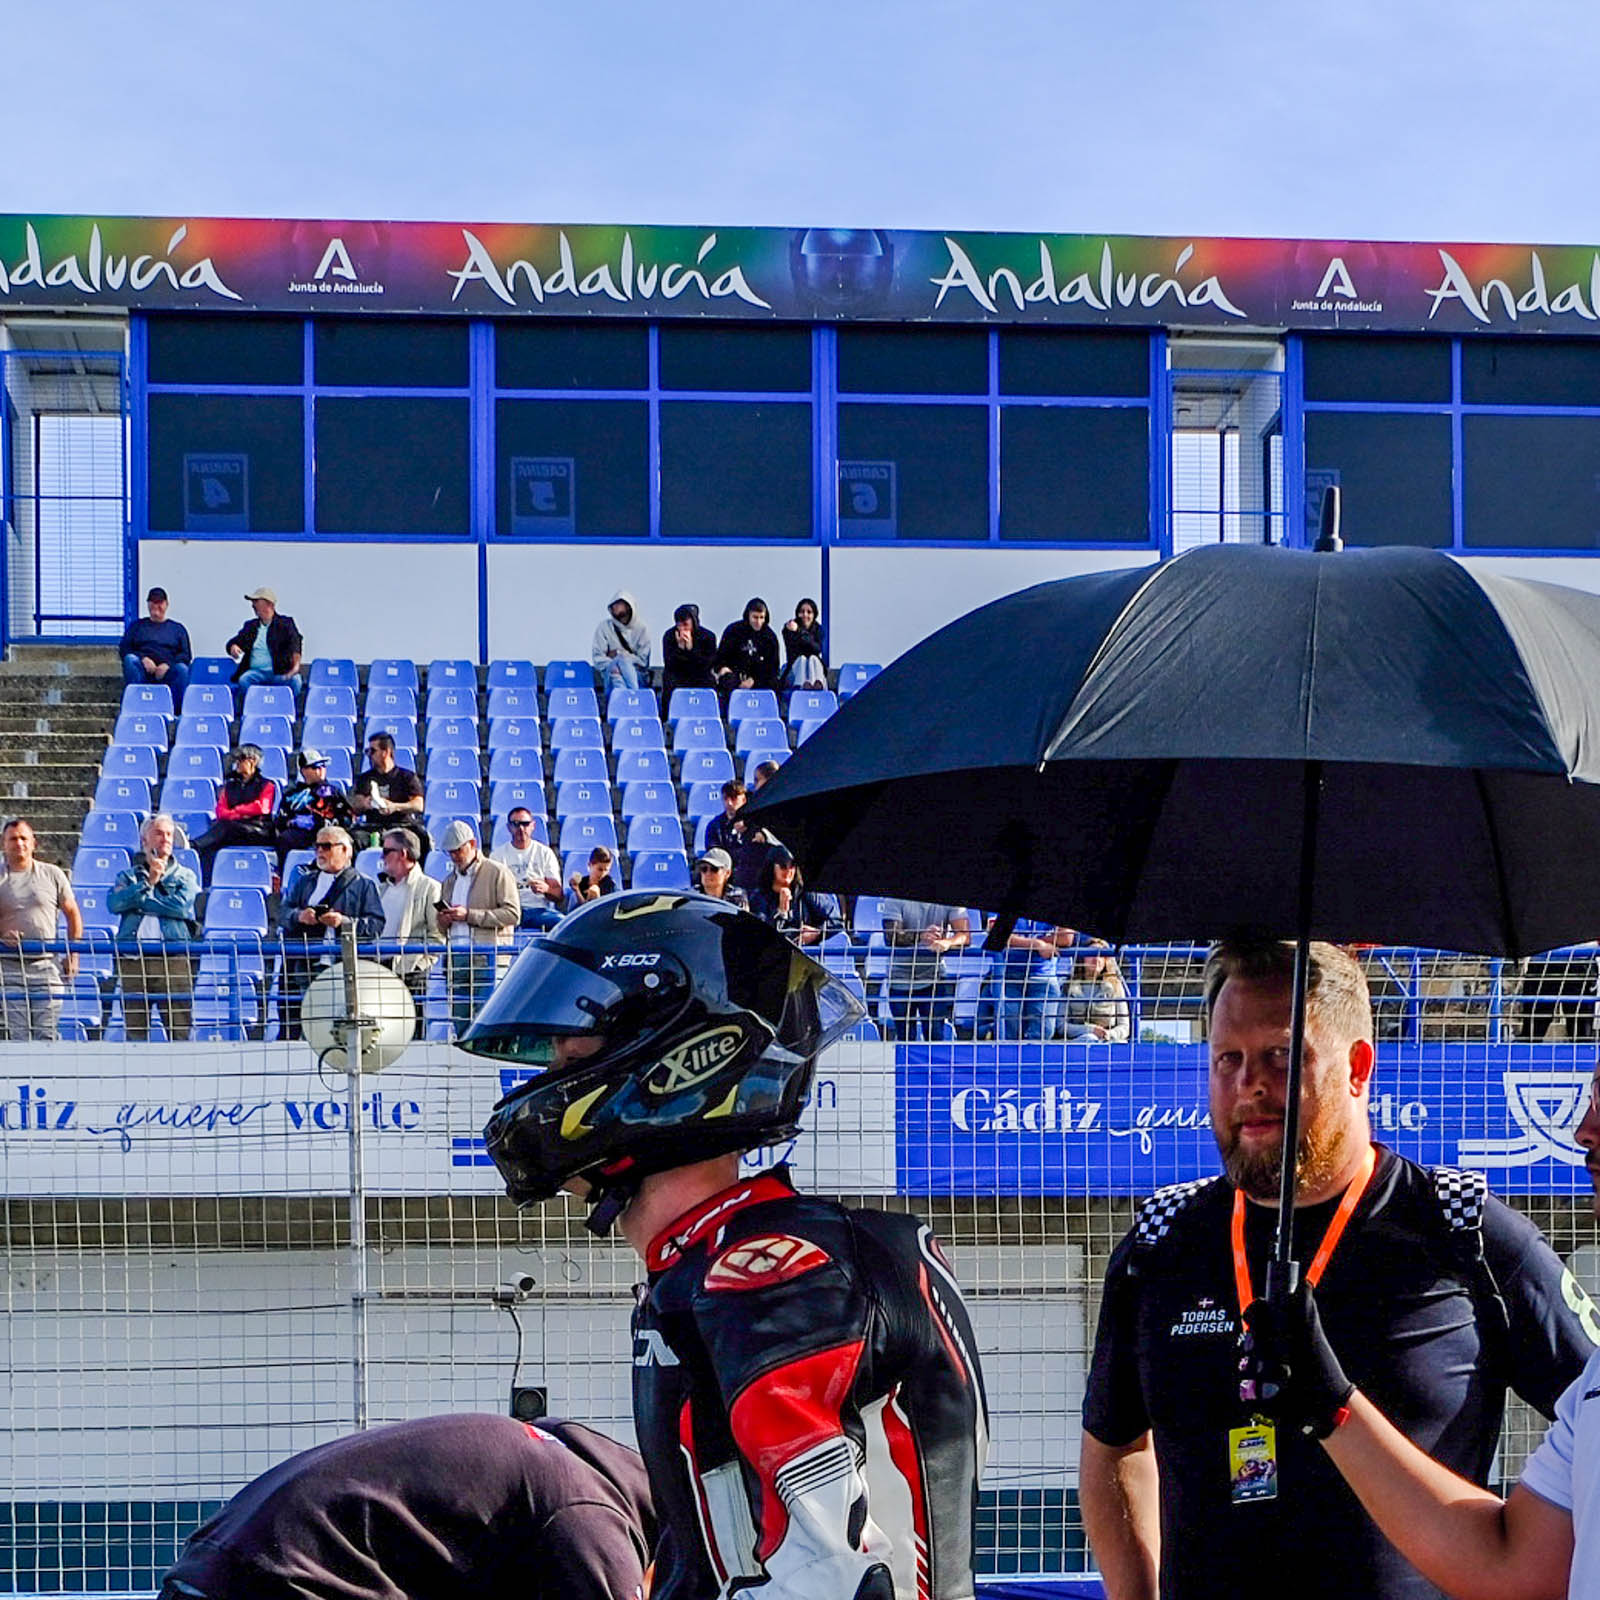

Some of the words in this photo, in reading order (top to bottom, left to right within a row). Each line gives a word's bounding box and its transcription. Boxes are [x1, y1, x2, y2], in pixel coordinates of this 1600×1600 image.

[447, 229, 771, 309] Andalucía
[930, 236, 1247, 318] Andalucía
[288, 282, 317, 295] Junta
[319, 283, 332, 294] de
[1291, 300, 1319, 312] Junta
[1320, 301, 1333, 311] de
[601, 953, 660, 968] X-803
[662, 1034, 738, 1093] X-lite
[86, 1099, 270, 1153] quiere
[281, 1091, 421, 1130] verte
[951, 1085, 1101, 1133] Cádiz
[1170, 1319, 1234, 1336] PEDERSEN
[1181, 1308, 1226, 1324] TOBIAS
